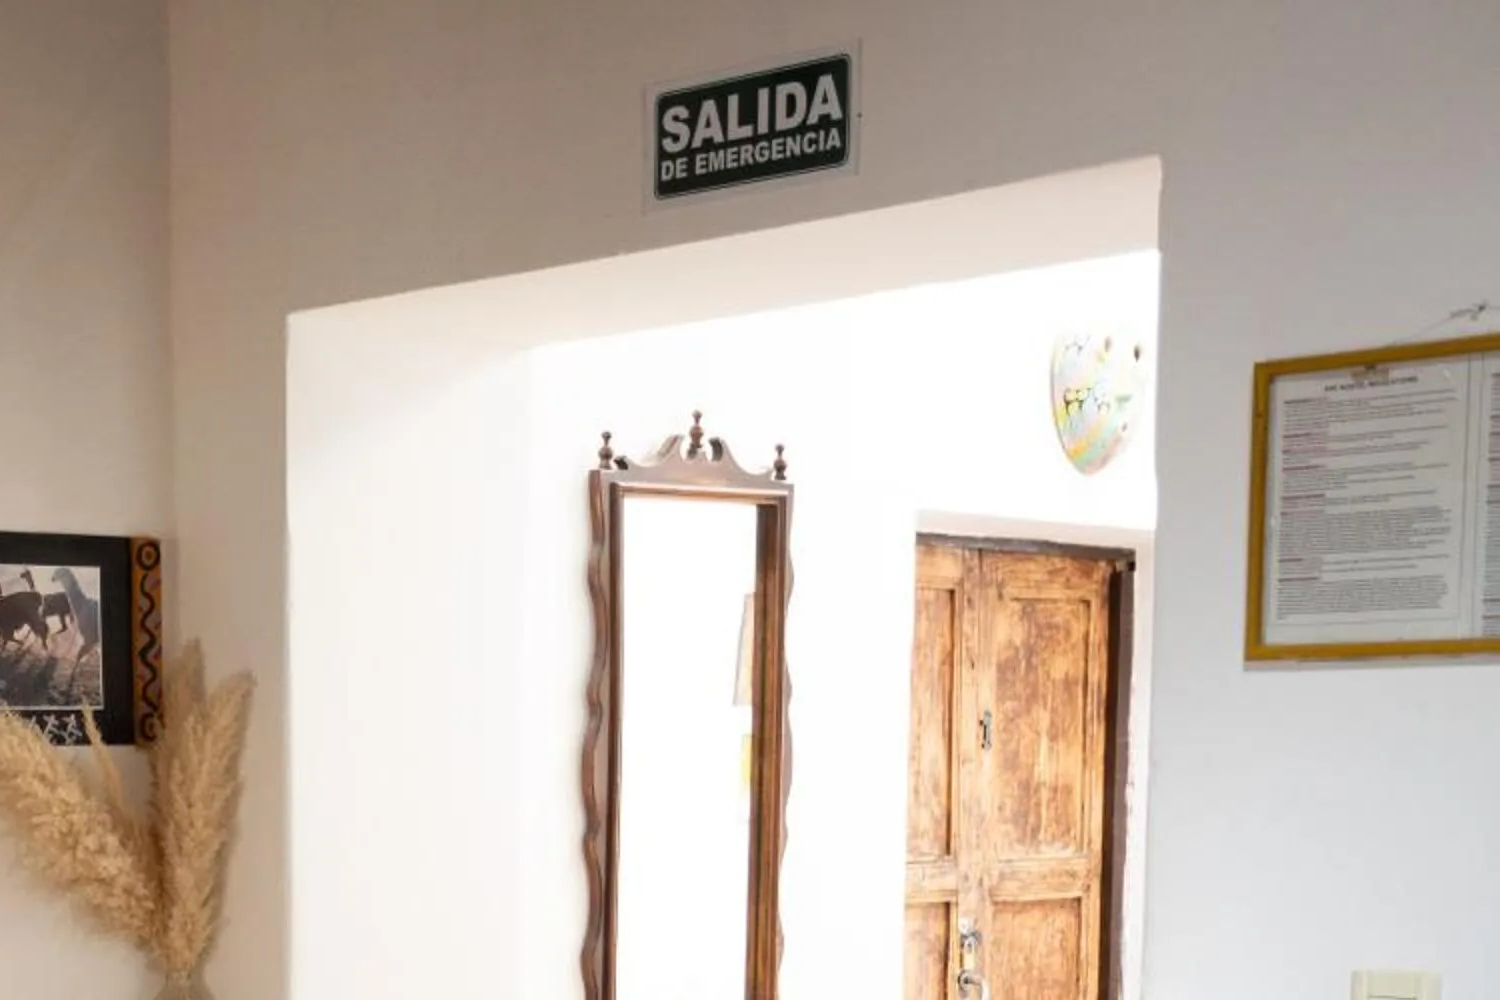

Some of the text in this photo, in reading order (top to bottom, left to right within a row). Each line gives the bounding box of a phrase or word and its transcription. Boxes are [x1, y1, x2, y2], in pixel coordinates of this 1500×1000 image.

[661, 73, 843, 153] SALIDA
[661, 127, 841, 182] DE EMERGENCIA
